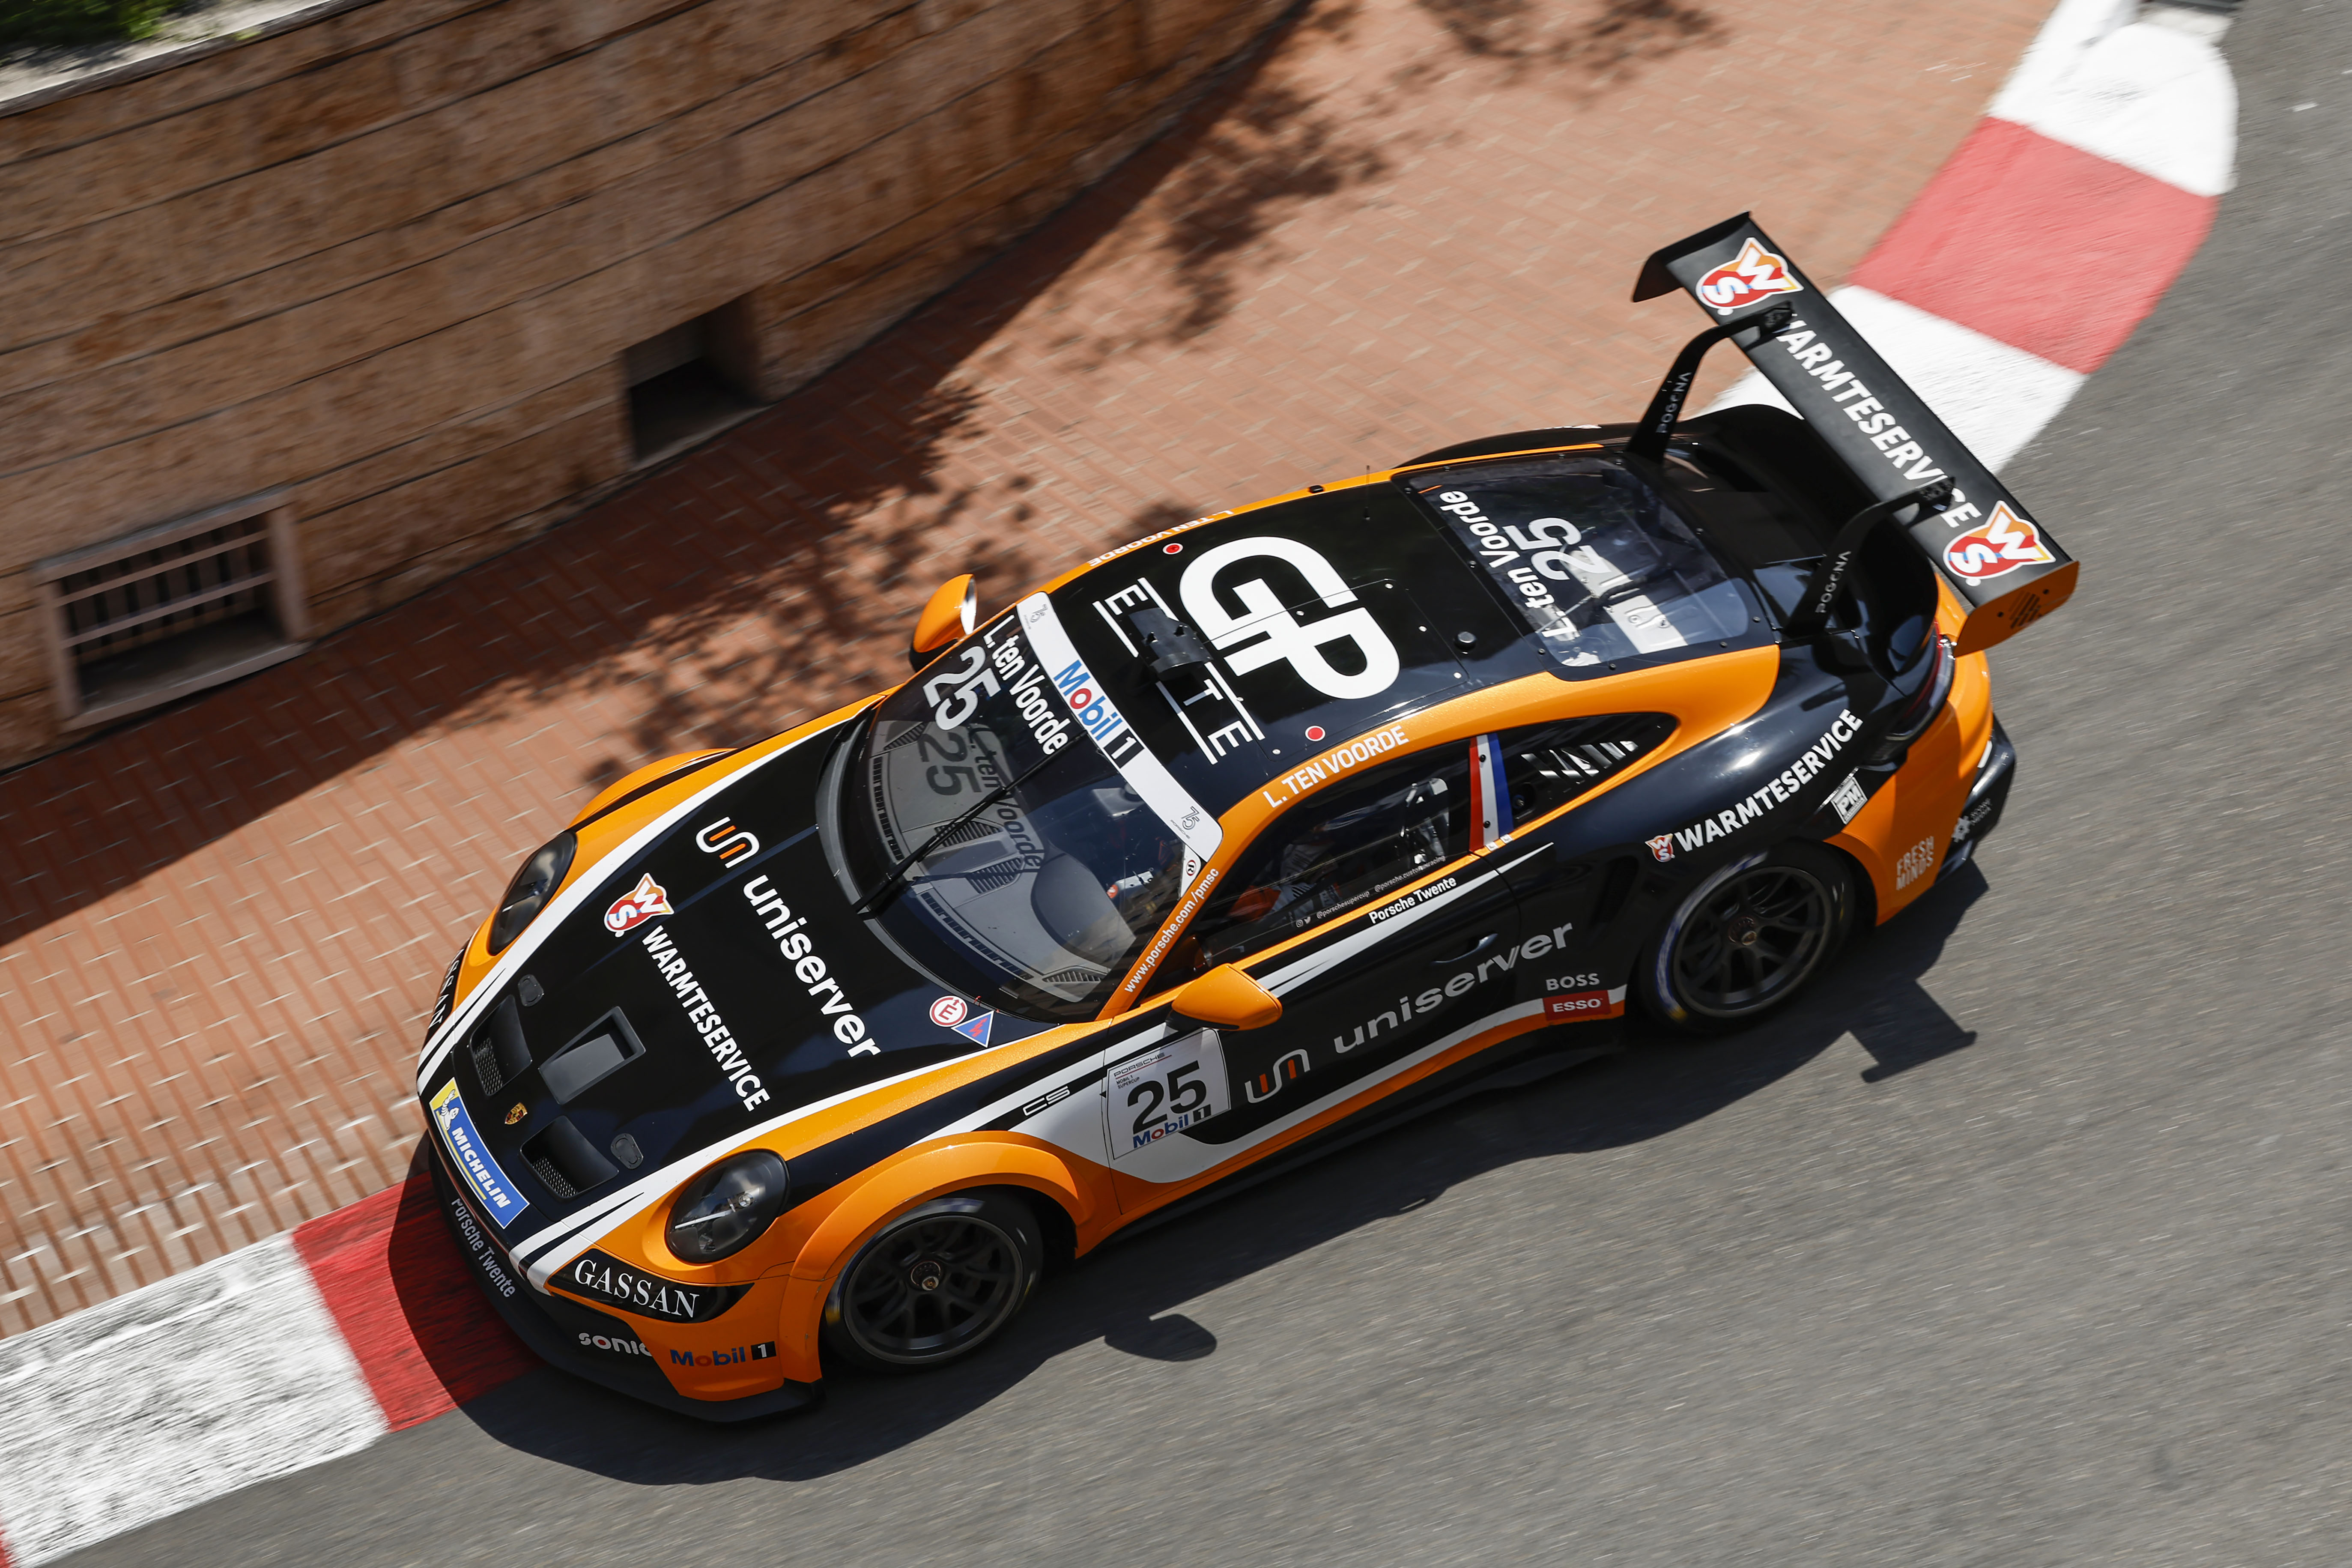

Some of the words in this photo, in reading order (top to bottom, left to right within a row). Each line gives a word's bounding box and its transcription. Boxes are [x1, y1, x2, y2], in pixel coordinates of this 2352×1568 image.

[1087, 531, 1173, 566] VOORDE
[1171, 517, 1215, 531] TEN
[1439, 491, 1520, 568] Voorde
[1502, 517, 1612, 580] 25
[1507, 567, 1555, 609] ten
[983, 615, 1015, 649] L.
[1179, 536, 1400, 699] GP
[991, 635, 1026, 681] ten
[1104, 584, 1253, 756] ETE
[922, 646, 1002, 730] 25
[1009, 664, 1071, 755] Voorde
[1054, 660, 1123, 741] Mobil
[1263, 790, 1288, 808] L.
[1281, 762, 1327, 795] TEN
[1321, 725, 1410, 774] VOORDE
[1675, 708, 1863, 853] WARMTESERVICE
[1181, 806, 1200, 830] 75
[1897, 836, 1934, 876] FRESH
[1316, 890, 1370, 919] @porschesupercup
[1369, 896, 1415, 923] Porsche
[1413, 877, 1457, 902] Twente
[743, 875, 881, 1058] uniserver
[1334, 923, 1573, 1054] uniserver
[1546, 973, 1600, 991] BOSS
[642, 925, 770, 1112] WARMTESERVICE
[1552, 999, 1601, 1012] ESSO
[1113, 1052, 1165, 1077] PORSCHE
[1116, 1076, 1130, 1085] MOBIL
[1117, 1077, 1140, 1089] SUPERCUP
[1128, 1060, 1207, 1135] 25
[1133, 1114, 1189, 1148] Mobil
[452, 1127, 511, 1208] MICHELIN
[451, 1198, 484, 1251] Porsche
[478, 1246, 516, 1297] Twente
[574, 1260, 700, 1318] GASSAN
[670, 1347, 746, 1367] Mobil
